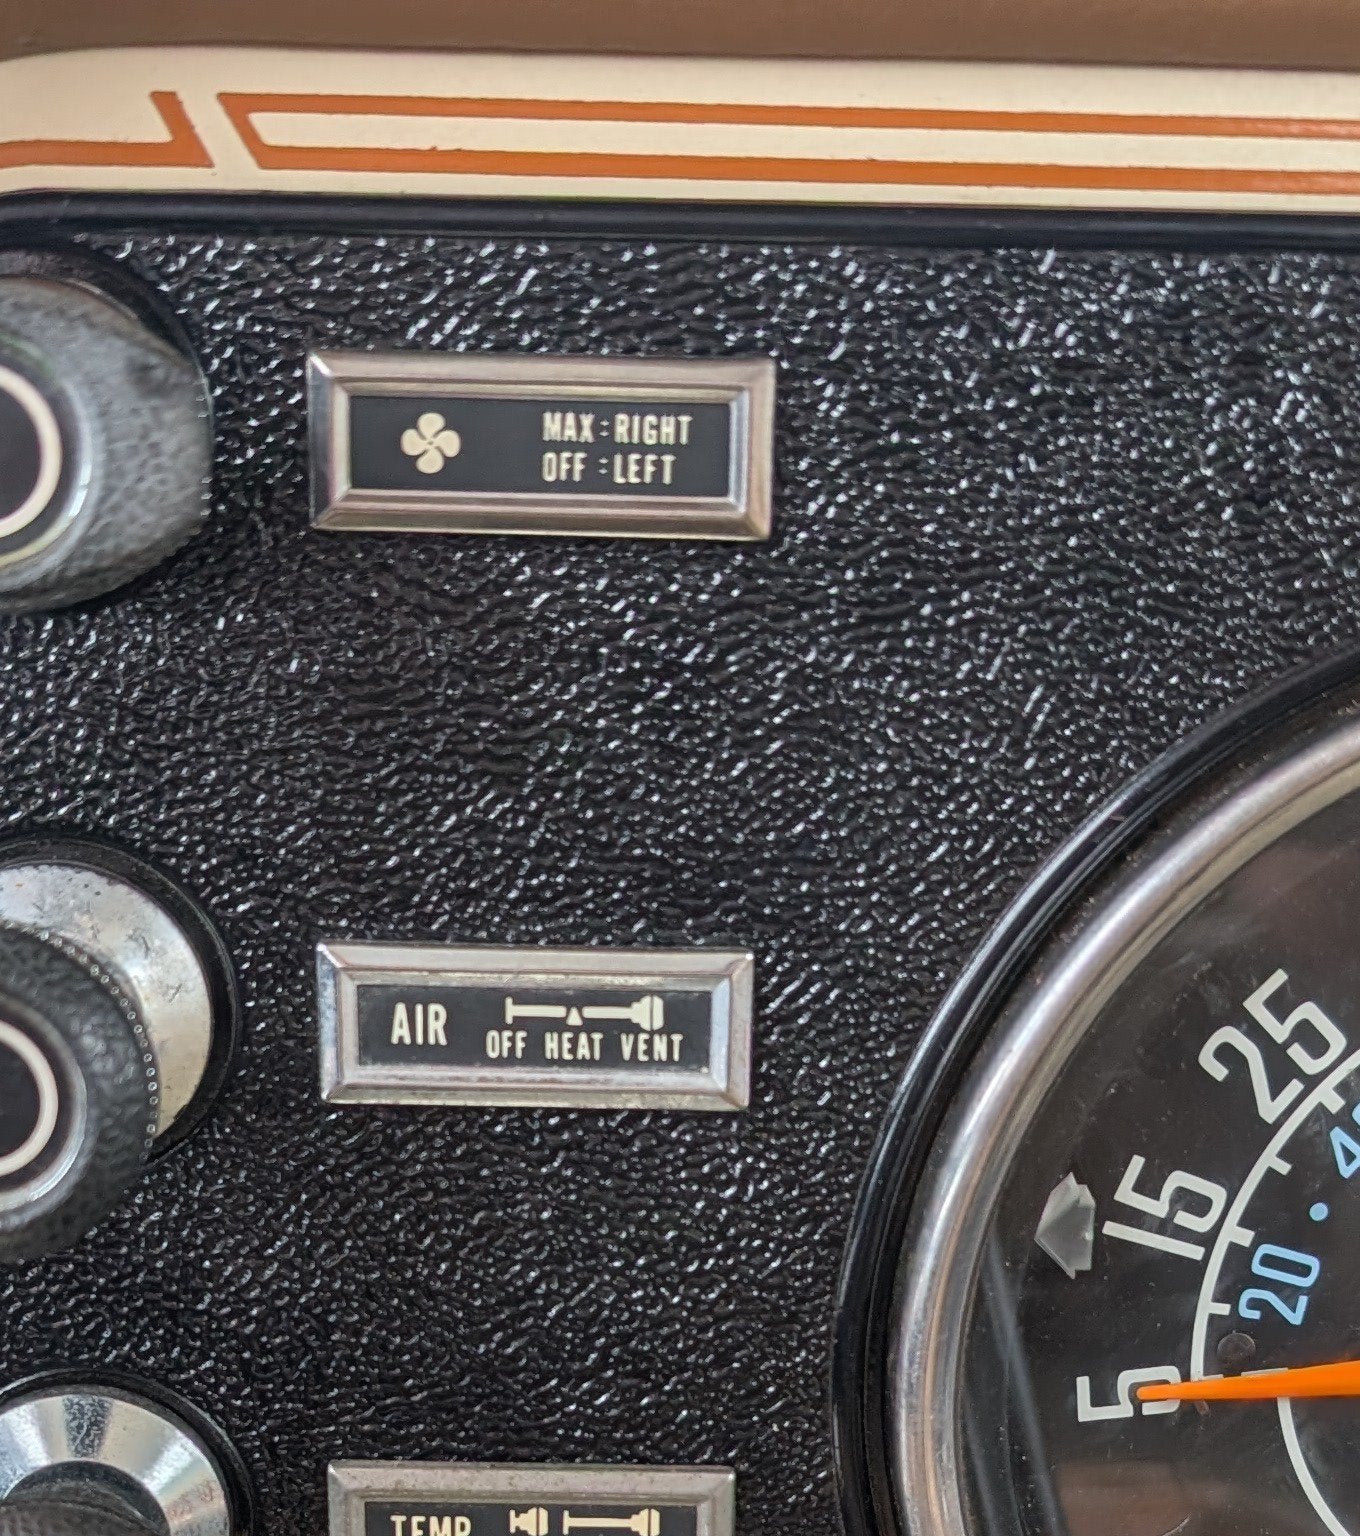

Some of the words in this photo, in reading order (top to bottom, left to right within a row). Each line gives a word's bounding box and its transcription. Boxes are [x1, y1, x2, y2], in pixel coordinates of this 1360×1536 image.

[542, 451, 588, 482] OFF
[613, 452, 677, 485] LEFT
[391, 1002, 448, 1046] AIR
[486, 1030, 527, 1059] OFF
[544, 1032, 604, 1061] HEAT
[620, 1033, 684, 1062] VENT
[1198, 968, 1348, 1125] 25
[1102, 1154, 1228, 1260] 15
[1238, 1242, 1321, 1326] 20
[1076, 1364, 1181, 1422] 5
